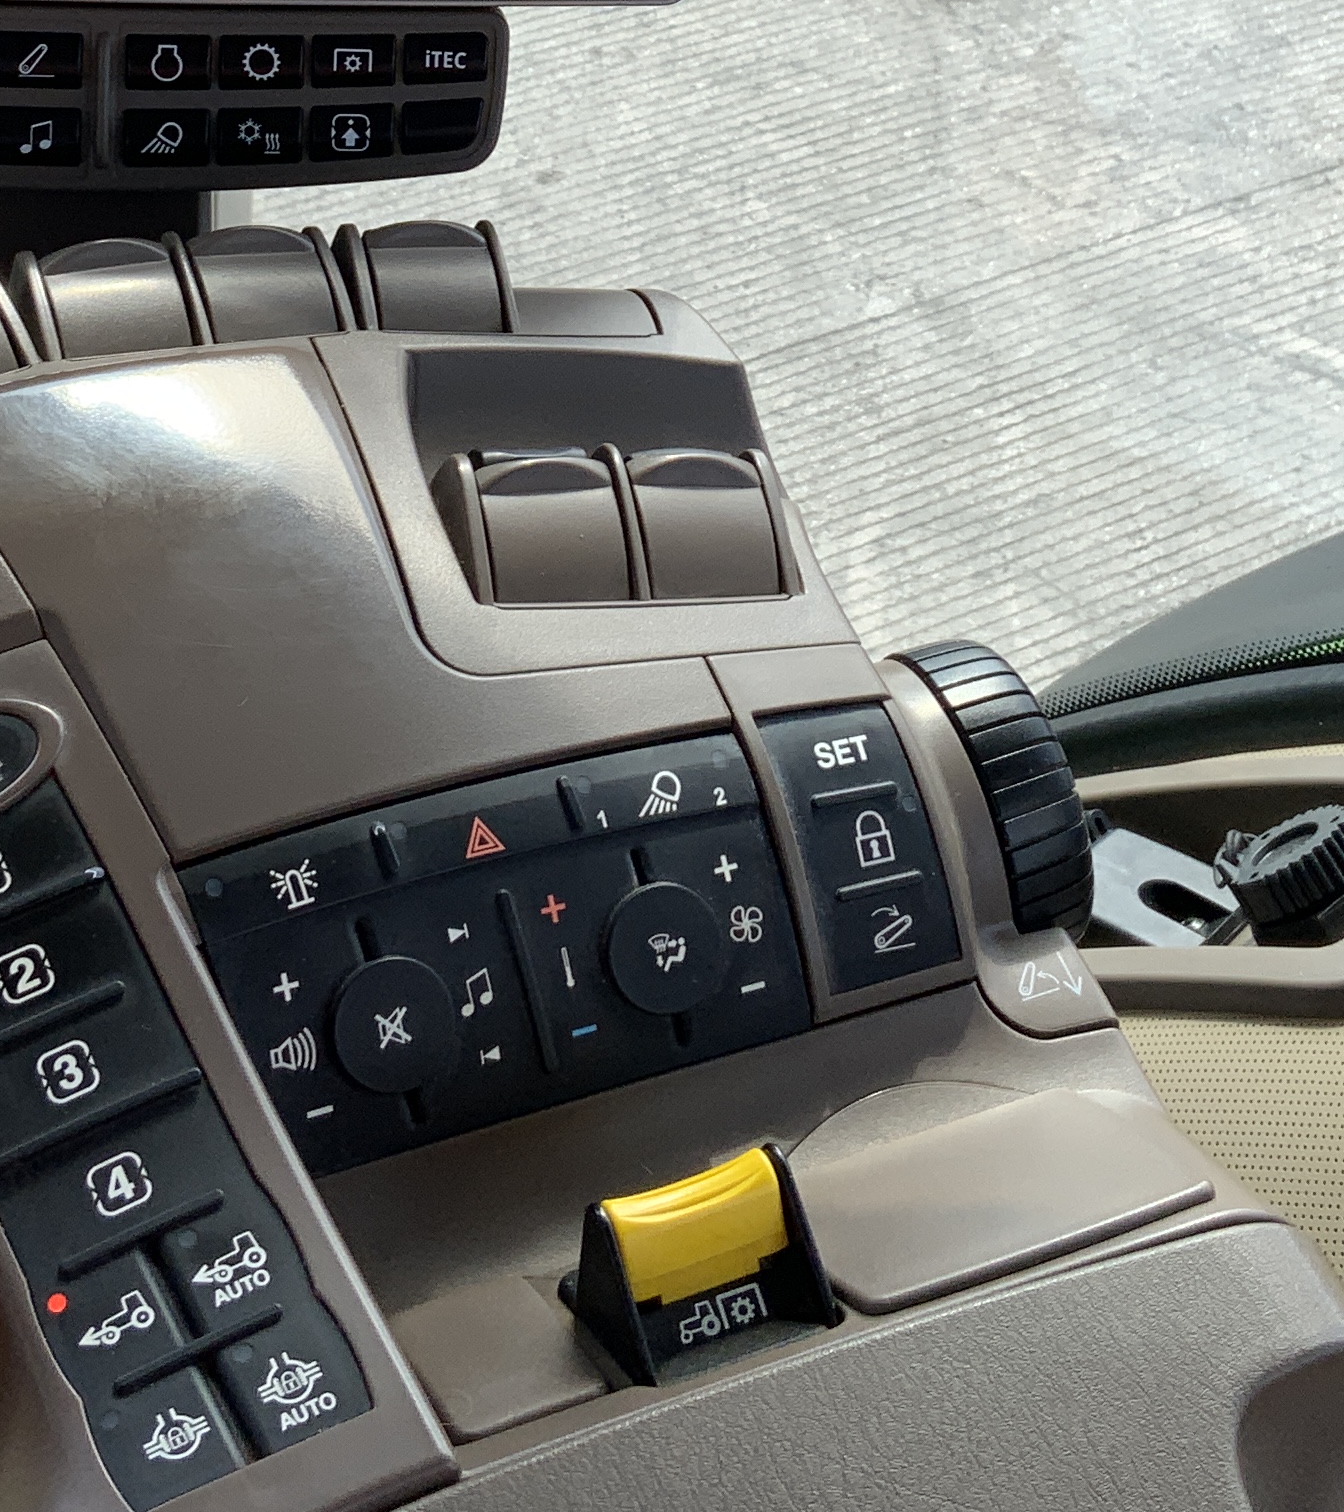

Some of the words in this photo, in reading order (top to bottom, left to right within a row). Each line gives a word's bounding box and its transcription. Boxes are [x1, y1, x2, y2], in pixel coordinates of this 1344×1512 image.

[425, 48, 468, 70] iTEC
[813, 734, 868, 770] SET
[596, 810, 610, 829] 1
[713, 787, 728, 807] 2
[8, 956, 42, 993] 2
[53, 1054, 85, 1090] 3
[105, 1165, 137, 1202] 4
[214, 1268, 272, 1309] AUTO
[279, 1392, 338, 1432] AUTO
